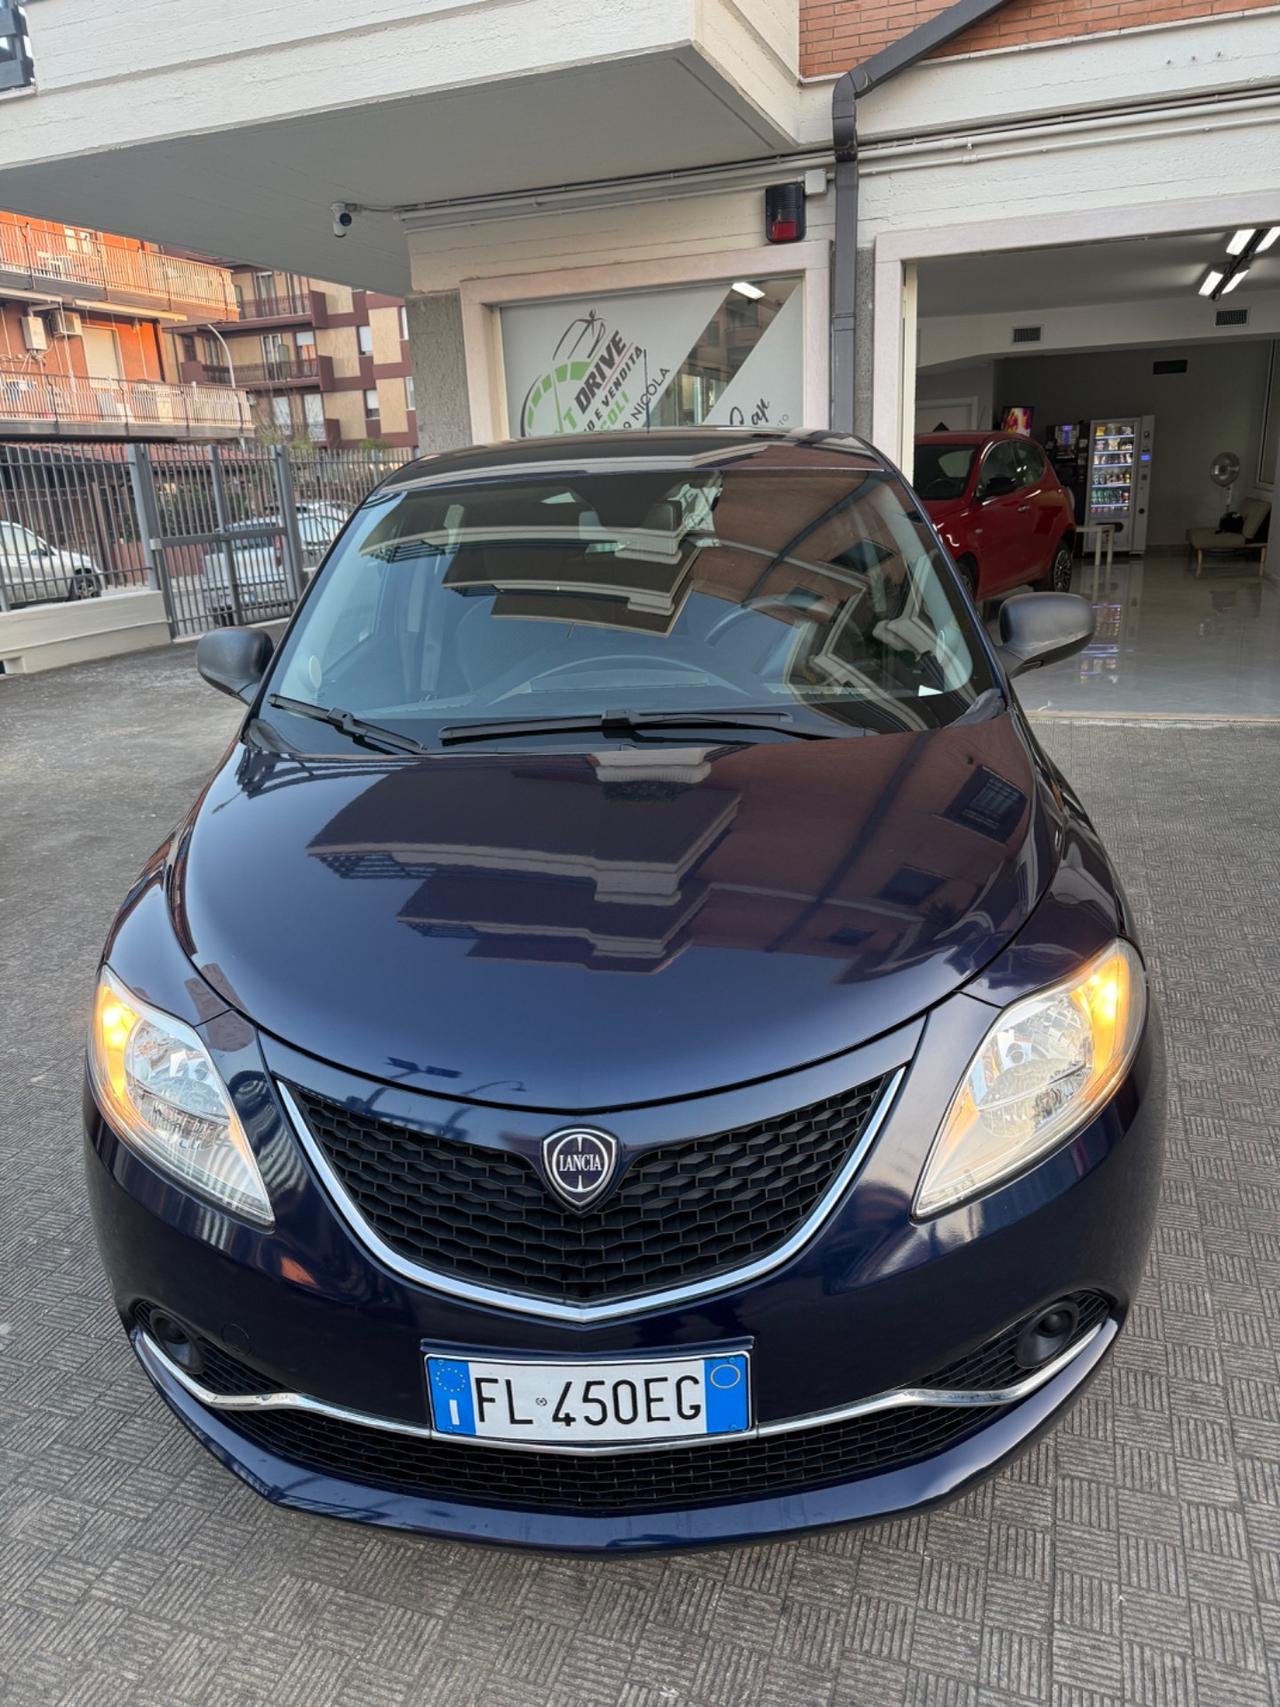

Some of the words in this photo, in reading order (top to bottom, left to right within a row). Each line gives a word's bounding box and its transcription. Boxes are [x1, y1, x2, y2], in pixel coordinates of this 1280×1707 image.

[575, 329, 626, 415] DRIVE
[594, 408, 603, 420] E
[601, 346, 643, 408] VENDITA
[630, 367, 670, 421] NICOLA
[559, 1154, 602, 1171] LANCIA
